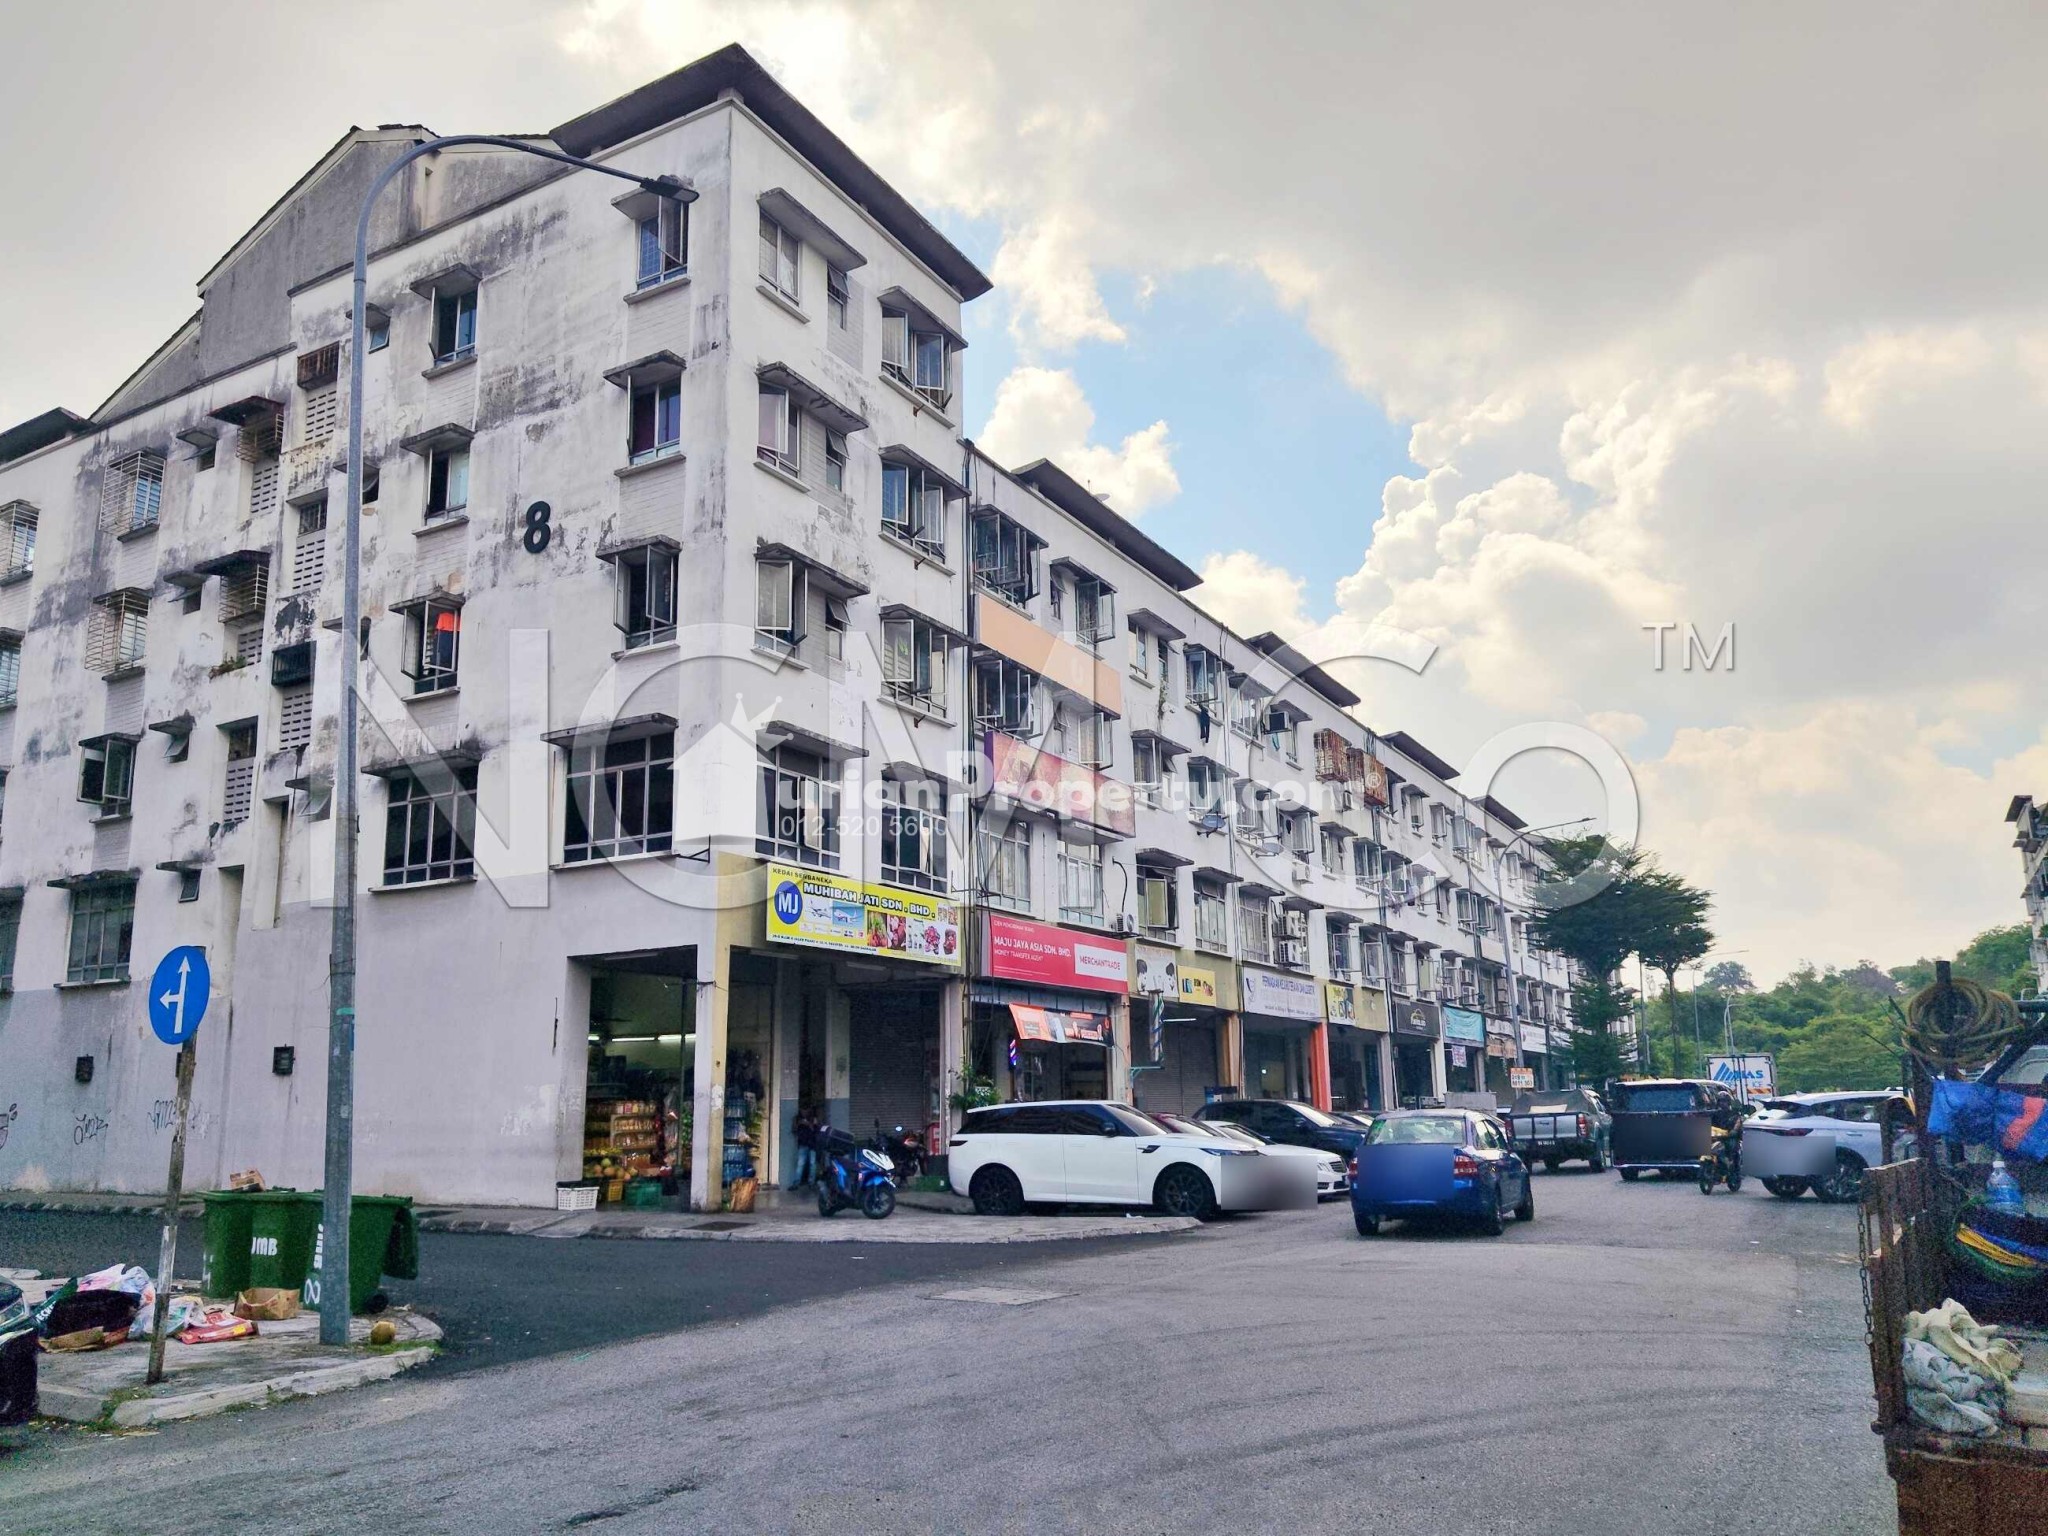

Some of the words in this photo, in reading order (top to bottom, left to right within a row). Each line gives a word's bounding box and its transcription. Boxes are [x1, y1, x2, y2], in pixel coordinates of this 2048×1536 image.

[524, 501, 551, 554] 8
[772, 867, 793, 877] KEDAI
[778, 891, 799, 915] MJ
[803, 882, 858, 903] MUHIBAH
[858, 893, 879, 906] JATI
[994, 936, 1012, 947] MAJU
[1013, 939, 1029, 950] JAYA
[1030, 942, 1043, 953] ASIA
[1044, 945, 1057, 954] SDN.
[1058, 947, 1071, 957] BHD.
[994, 949, 1010, 957] MONEY
[1010, 951, 1030, 959] TRANSFER
[1080, 955, 1121, 970] MERCHANTRADE
